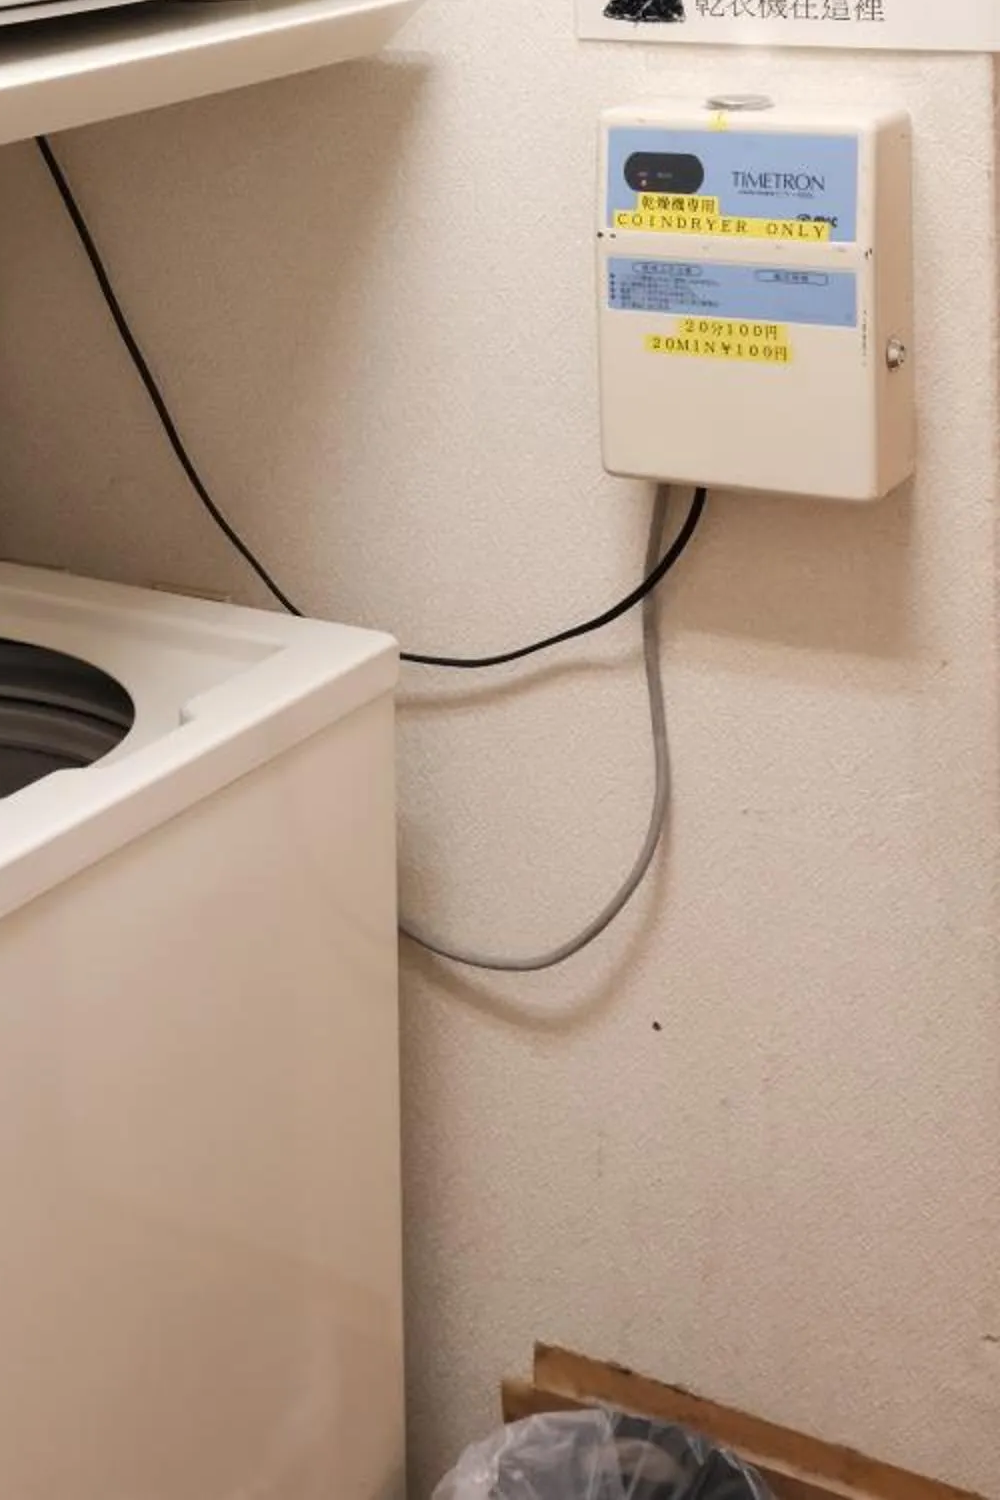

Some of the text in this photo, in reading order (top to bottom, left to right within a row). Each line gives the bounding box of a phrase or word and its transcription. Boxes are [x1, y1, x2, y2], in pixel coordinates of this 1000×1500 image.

[732, 171, 825, 193] TIMETRON
[616, 213, 826, 239] COINDRYER ONLY
